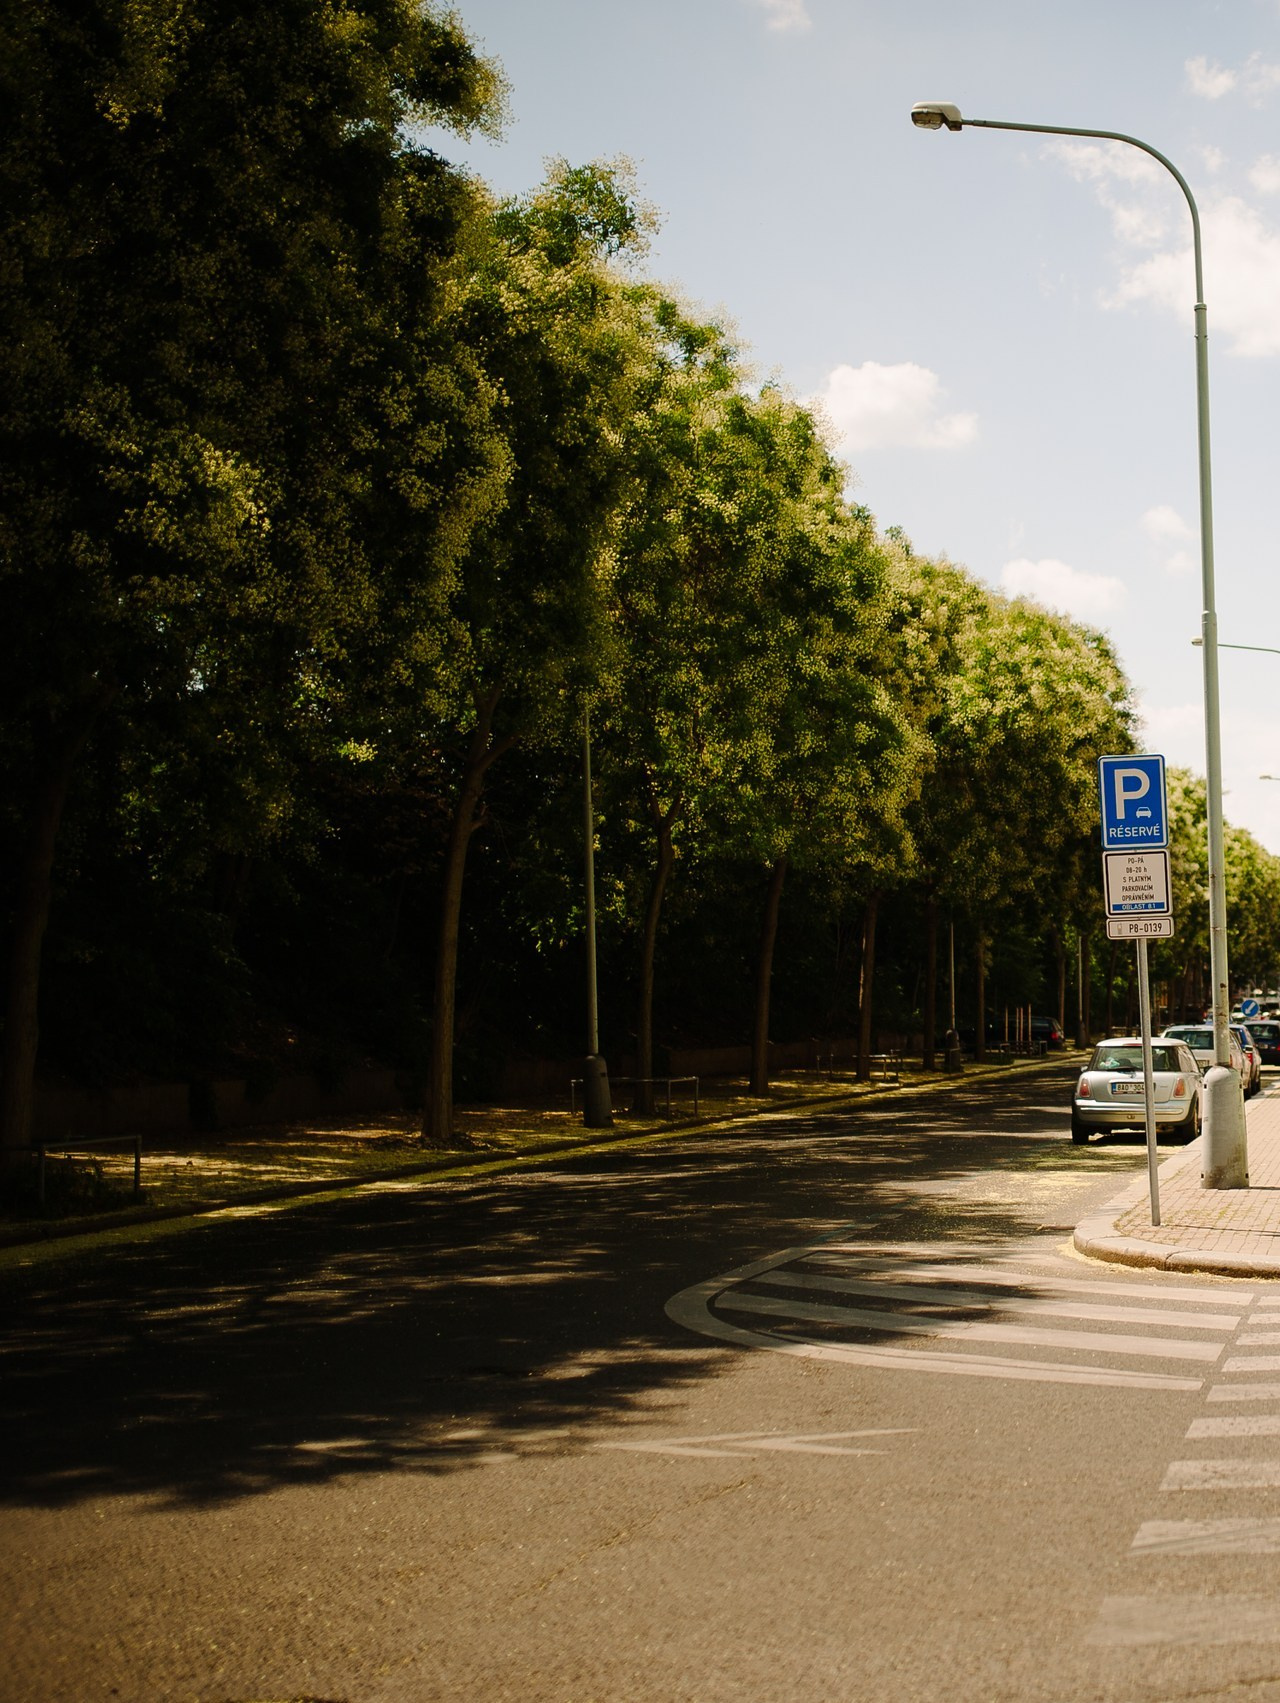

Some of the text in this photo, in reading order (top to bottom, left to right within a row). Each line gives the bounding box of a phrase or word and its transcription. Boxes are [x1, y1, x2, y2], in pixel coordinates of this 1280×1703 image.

[1114, 768, 1150, 820] P
[1109, 823, 1160, 838] RÉSERVÉ
[1127, 856, 1144, 864] PO-PÁ
[1128, 874, 1152, 882] PLATNÝM
[1121, 883, 1153, 892] PARKOVACÍM
[1129, 922, 1162, 933] P8-0139
